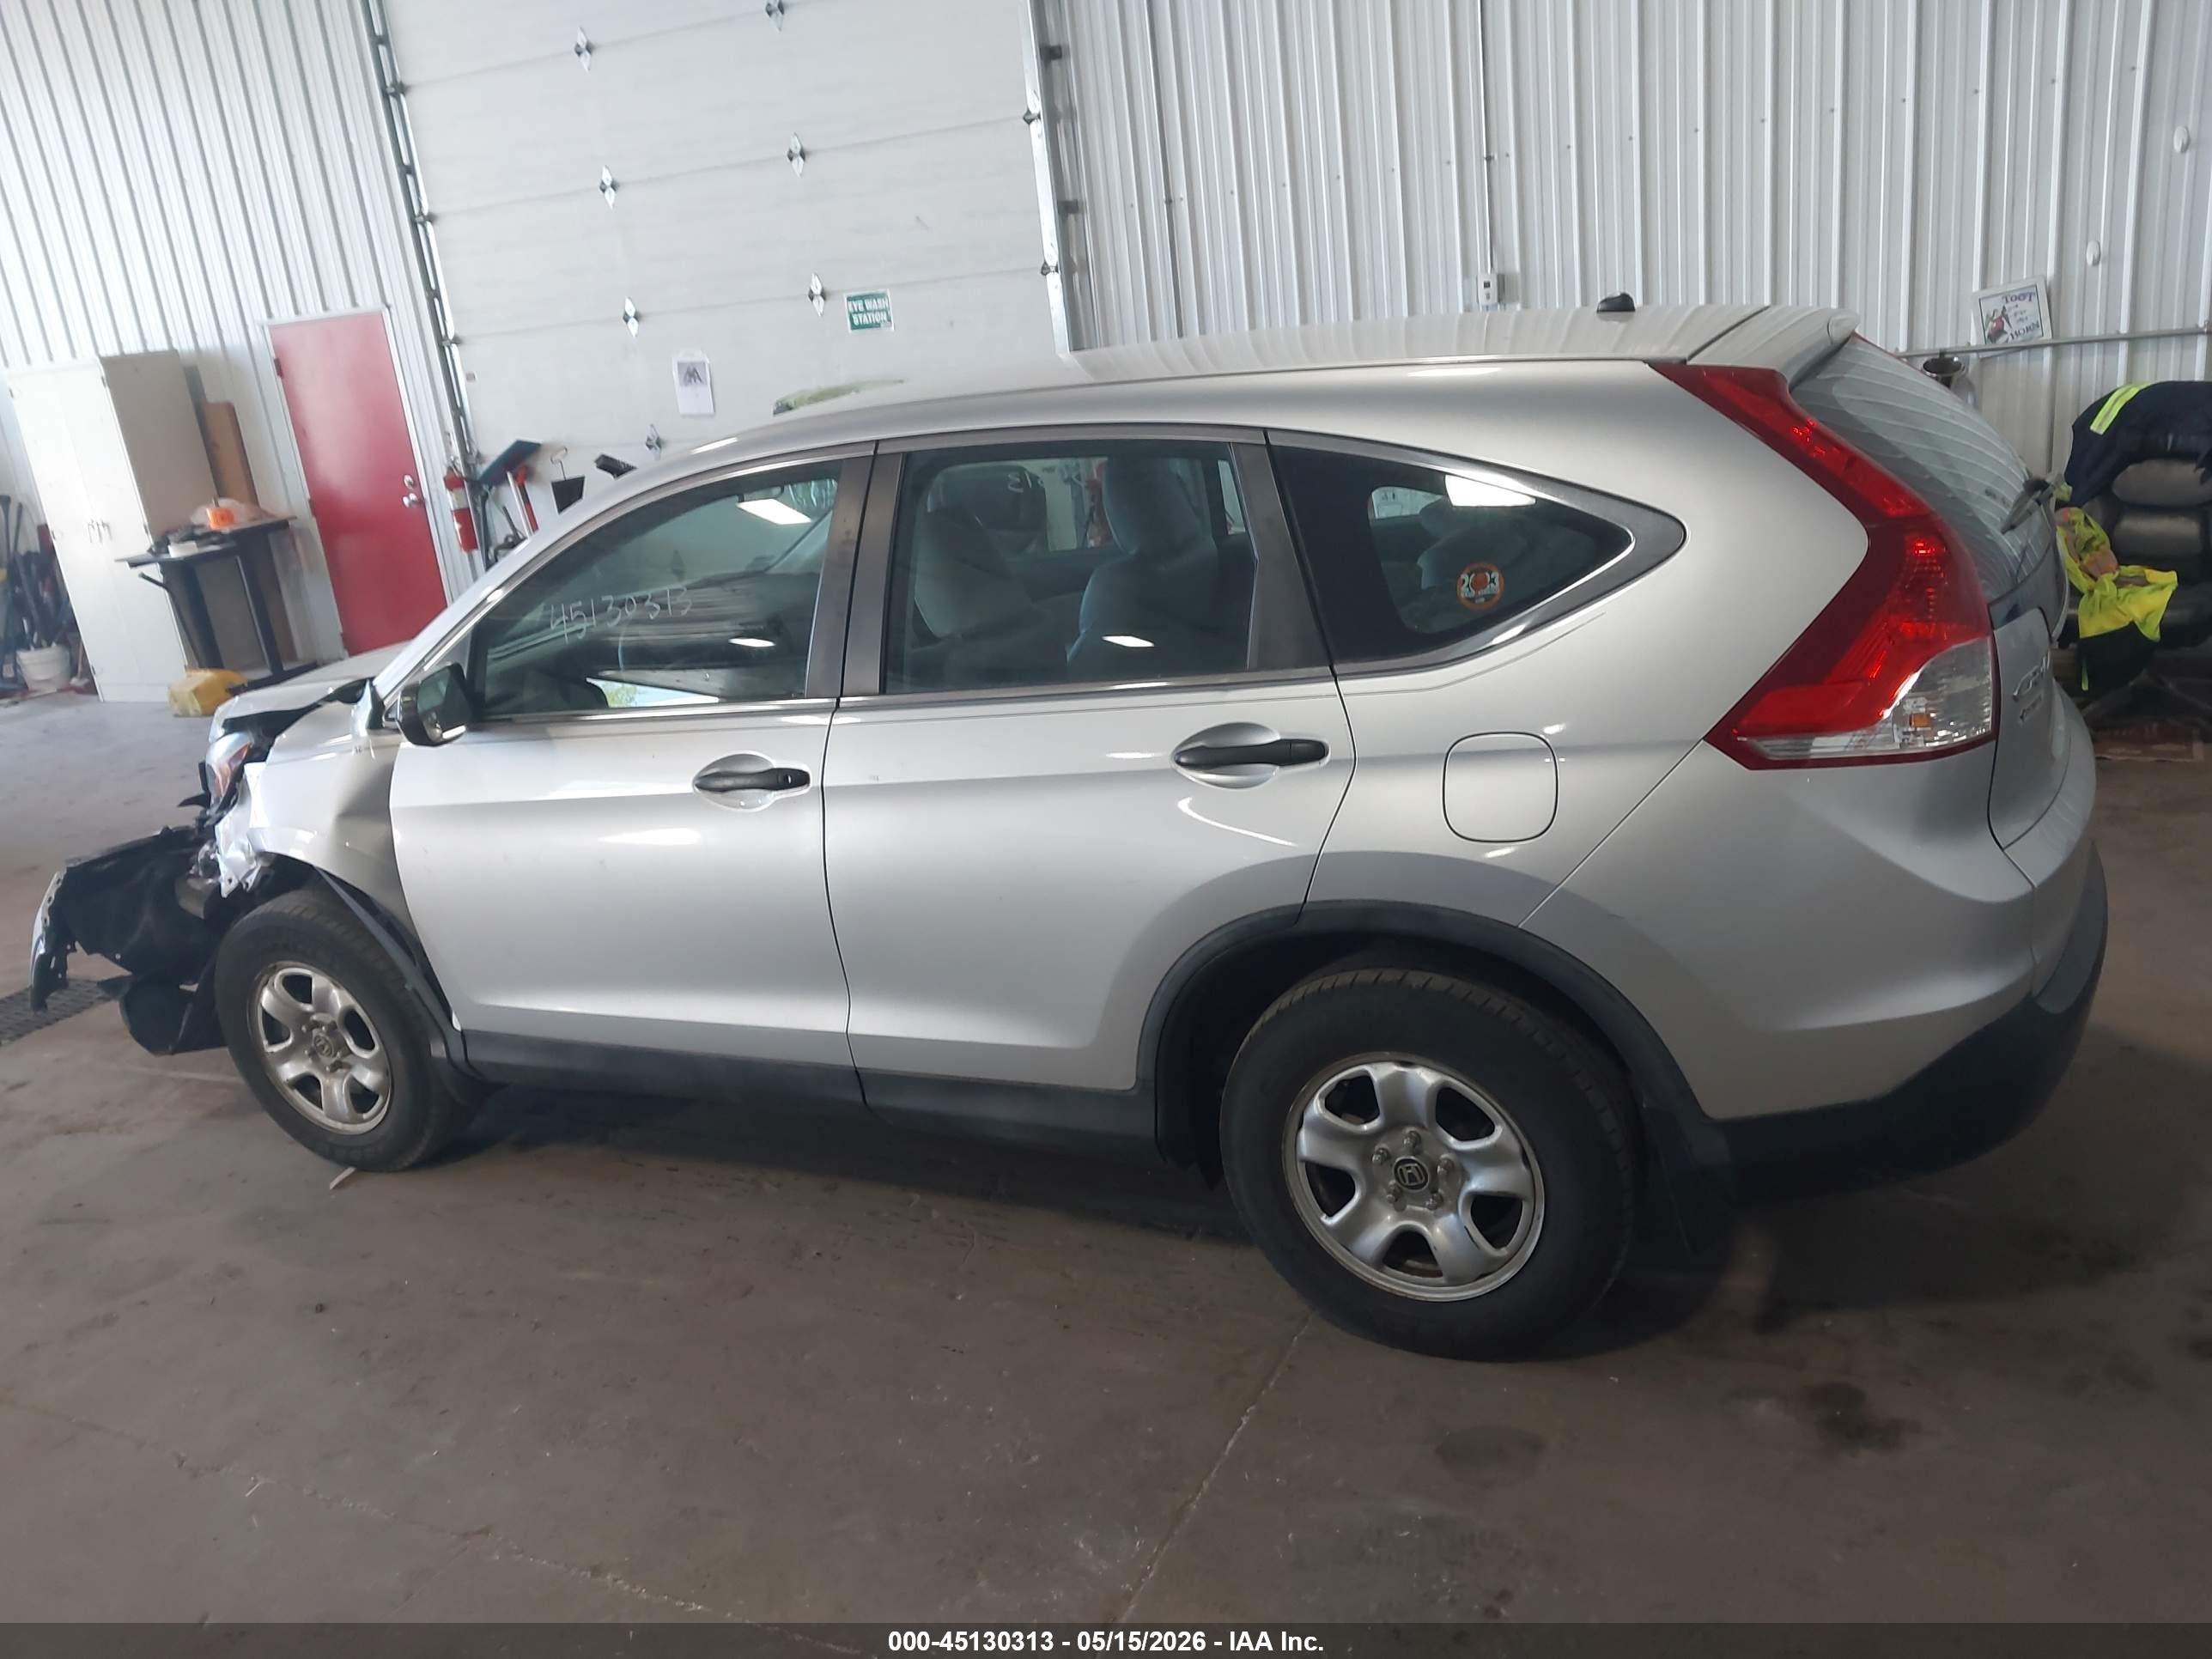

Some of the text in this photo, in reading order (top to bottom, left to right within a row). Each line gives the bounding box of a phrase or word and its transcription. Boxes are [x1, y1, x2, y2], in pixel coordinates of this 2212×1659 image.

[848, 296, 889, 313] EYE WASH
[852, 311, 888, 326] STATION
[550, 585, 692, 644] 45130313
